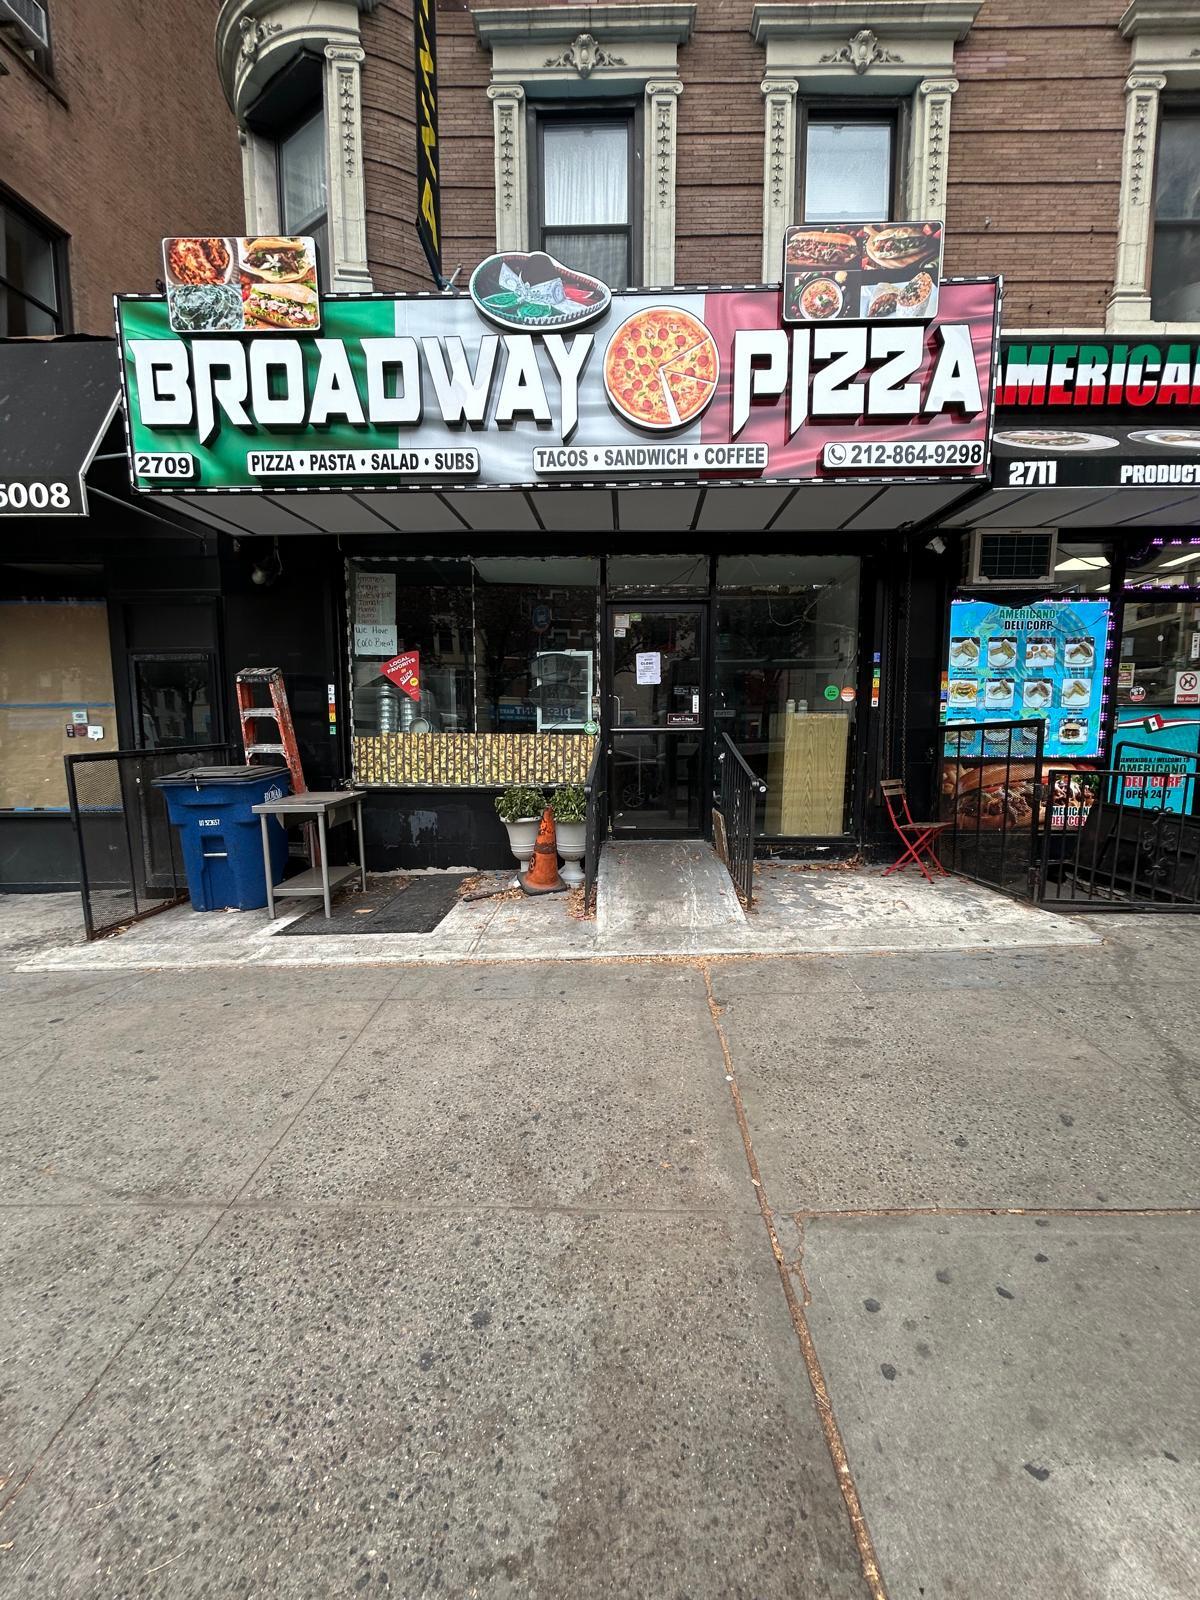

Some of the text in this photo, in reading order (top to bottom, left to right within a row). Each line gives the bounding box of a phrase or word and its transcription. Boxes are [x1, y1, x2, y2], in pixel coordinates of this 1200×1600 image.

[127, 324, 984, 445] BROADWAY PIZZA
[995, 344, 1200, 407] MERICA
[251, 452, 475, 472] PIZZA PASTA SALAD SUBS
[537, 447, 765, 467] TACOS SANDWICH COFFEE
[850, 444, 982, 464] 212-864-9298
[137, 456, 190, 475] 2709
[1009, 461, 1058, 485] 2711
[999, 609, 1056, 619] AMERICANO
[1004, 620, 1024, 630] DELI
[387, 657, 416, 674] FAVORITE
[389, 656, 410, 667] LOCAL
[1126, 789, 1172, 799] OPEN 247
